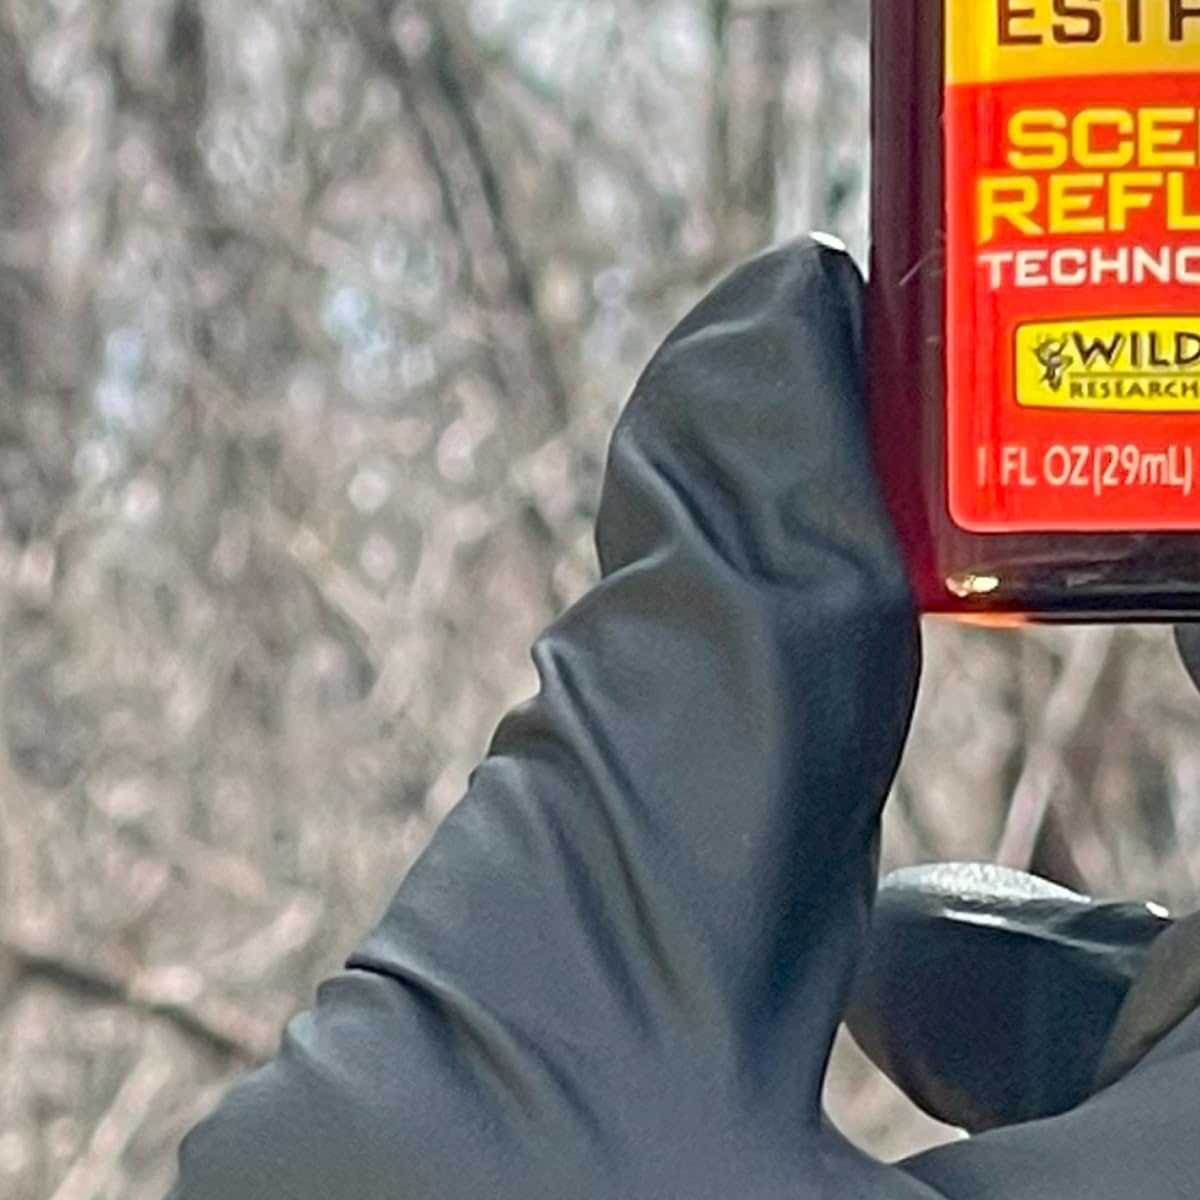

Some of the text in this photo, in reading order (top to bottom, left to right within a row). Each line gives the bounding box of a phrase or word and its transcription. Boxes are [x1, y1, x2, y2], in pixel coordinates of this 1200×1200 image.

[1070, 380, 1199, 399] RESEARCH
[977, 447, 986, 484] 1
[1001, 446, 1035, 486] FL
